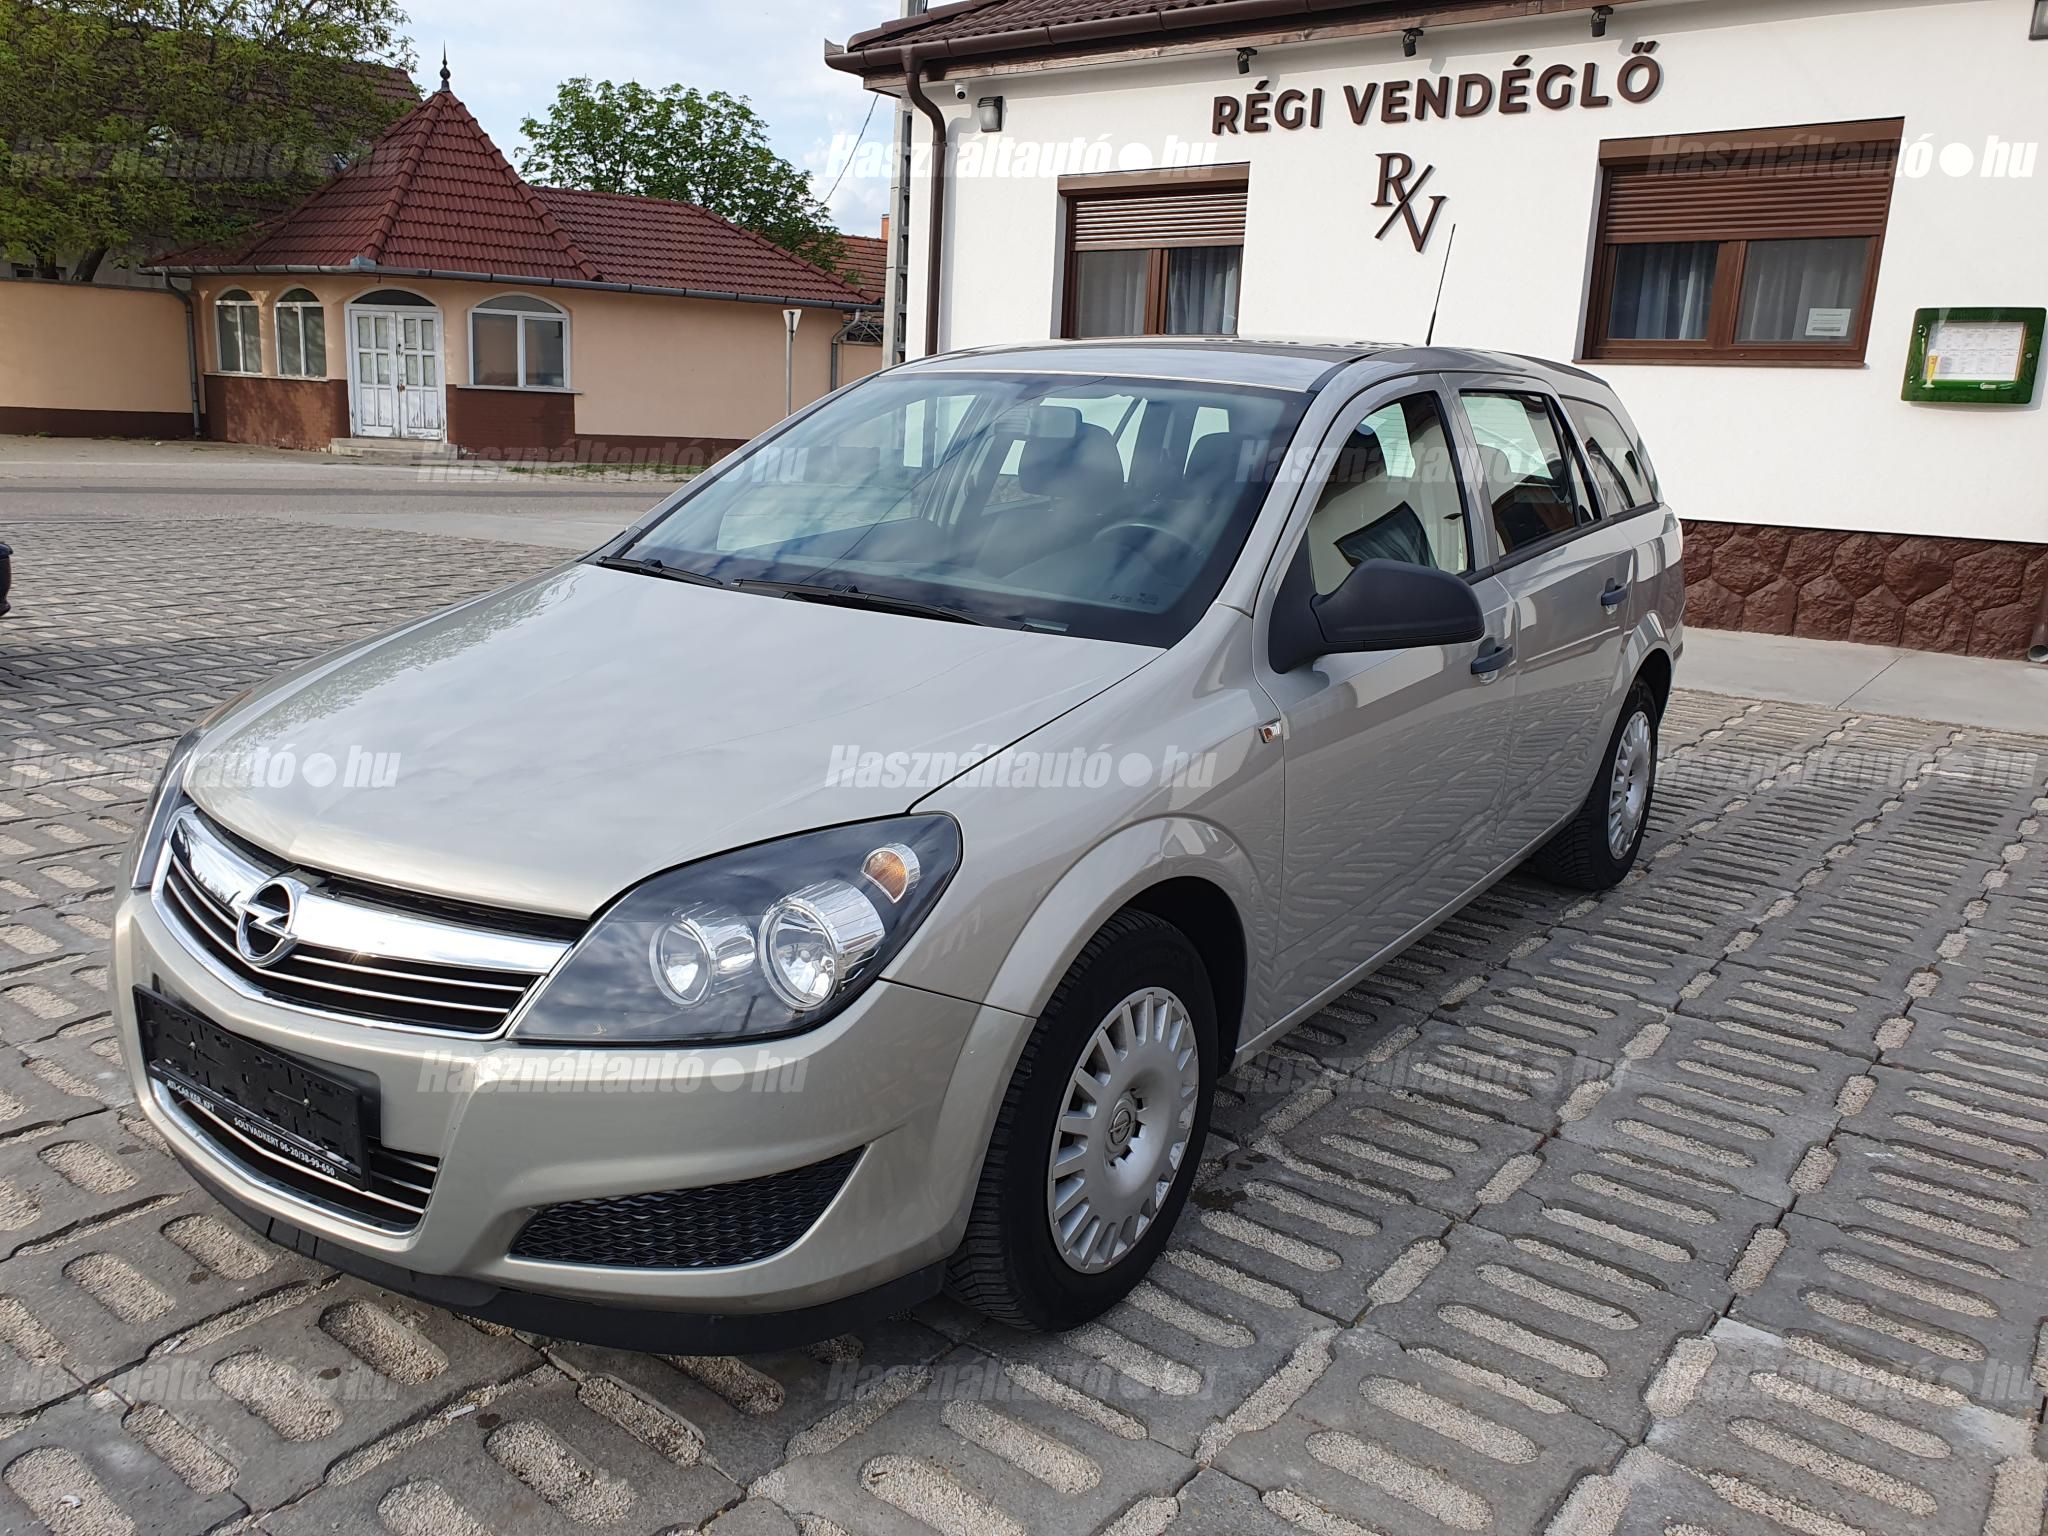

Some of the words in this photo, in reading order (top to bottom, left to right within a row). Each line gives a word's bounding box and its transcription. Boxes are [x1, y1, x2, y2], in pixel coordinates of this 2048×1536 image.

[1211, 79, 1323, 135] RÉGI
[1343, 40, 1662, 125] VENDÉGLŐ
[233, 1117, 279, 1148] SOLTVADKERT
